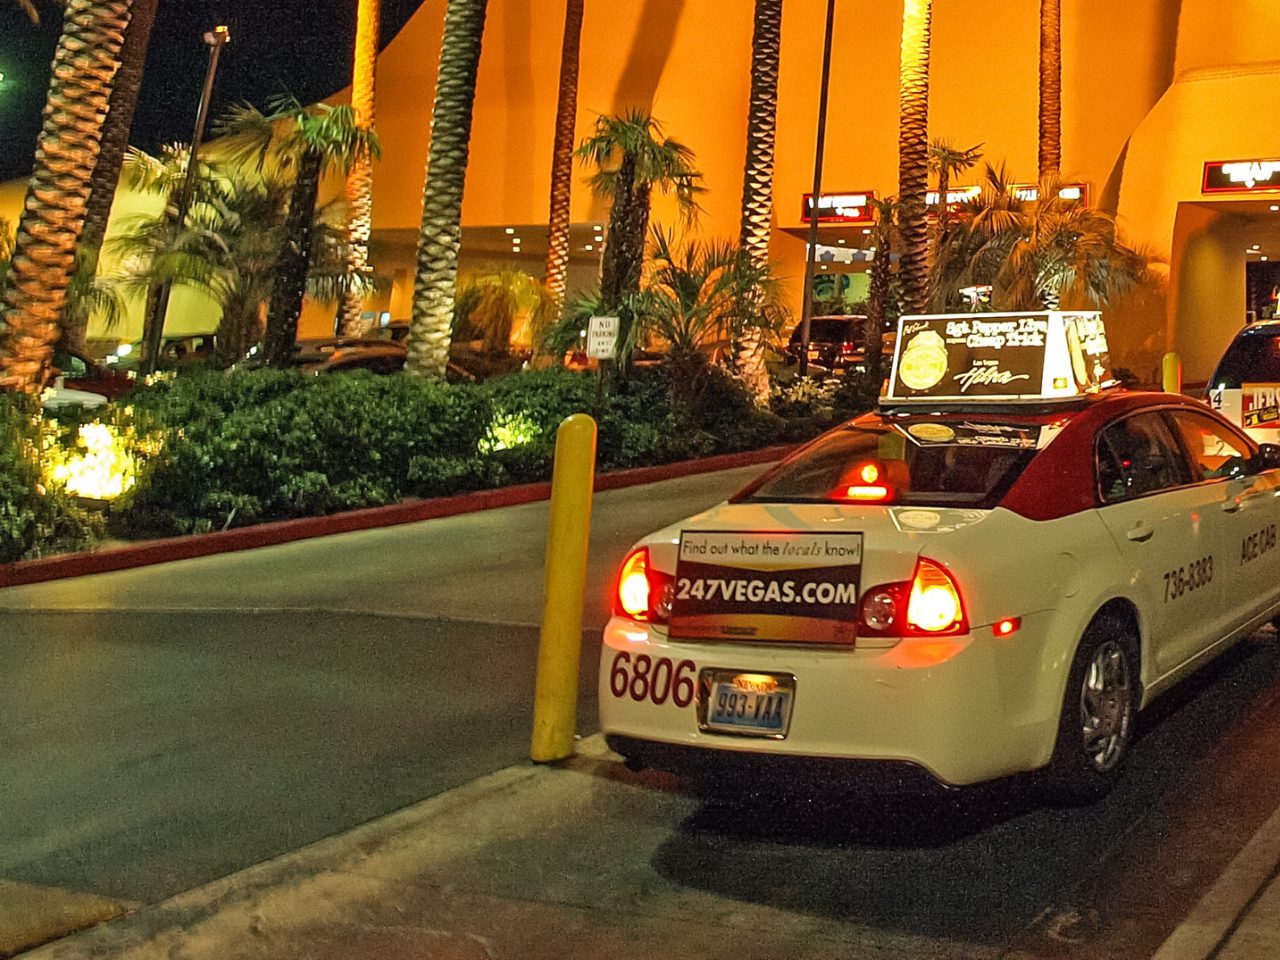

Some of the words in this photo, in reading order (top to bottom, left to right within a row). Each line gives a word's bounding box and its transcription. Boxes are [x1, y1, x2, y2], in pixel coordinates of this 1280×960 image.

[683, 541, 707, 554] Find
[710, 543, 728, 554] out
[731, 541, 760, 555] what
[762, 541, 779, 555] the
[782, 542, 822, 556] locals
[824, 541, 860, 557] know!
[676, 578, 857, 605] 247VEGAS.COM
[610, 650, 696, 708] 6806
